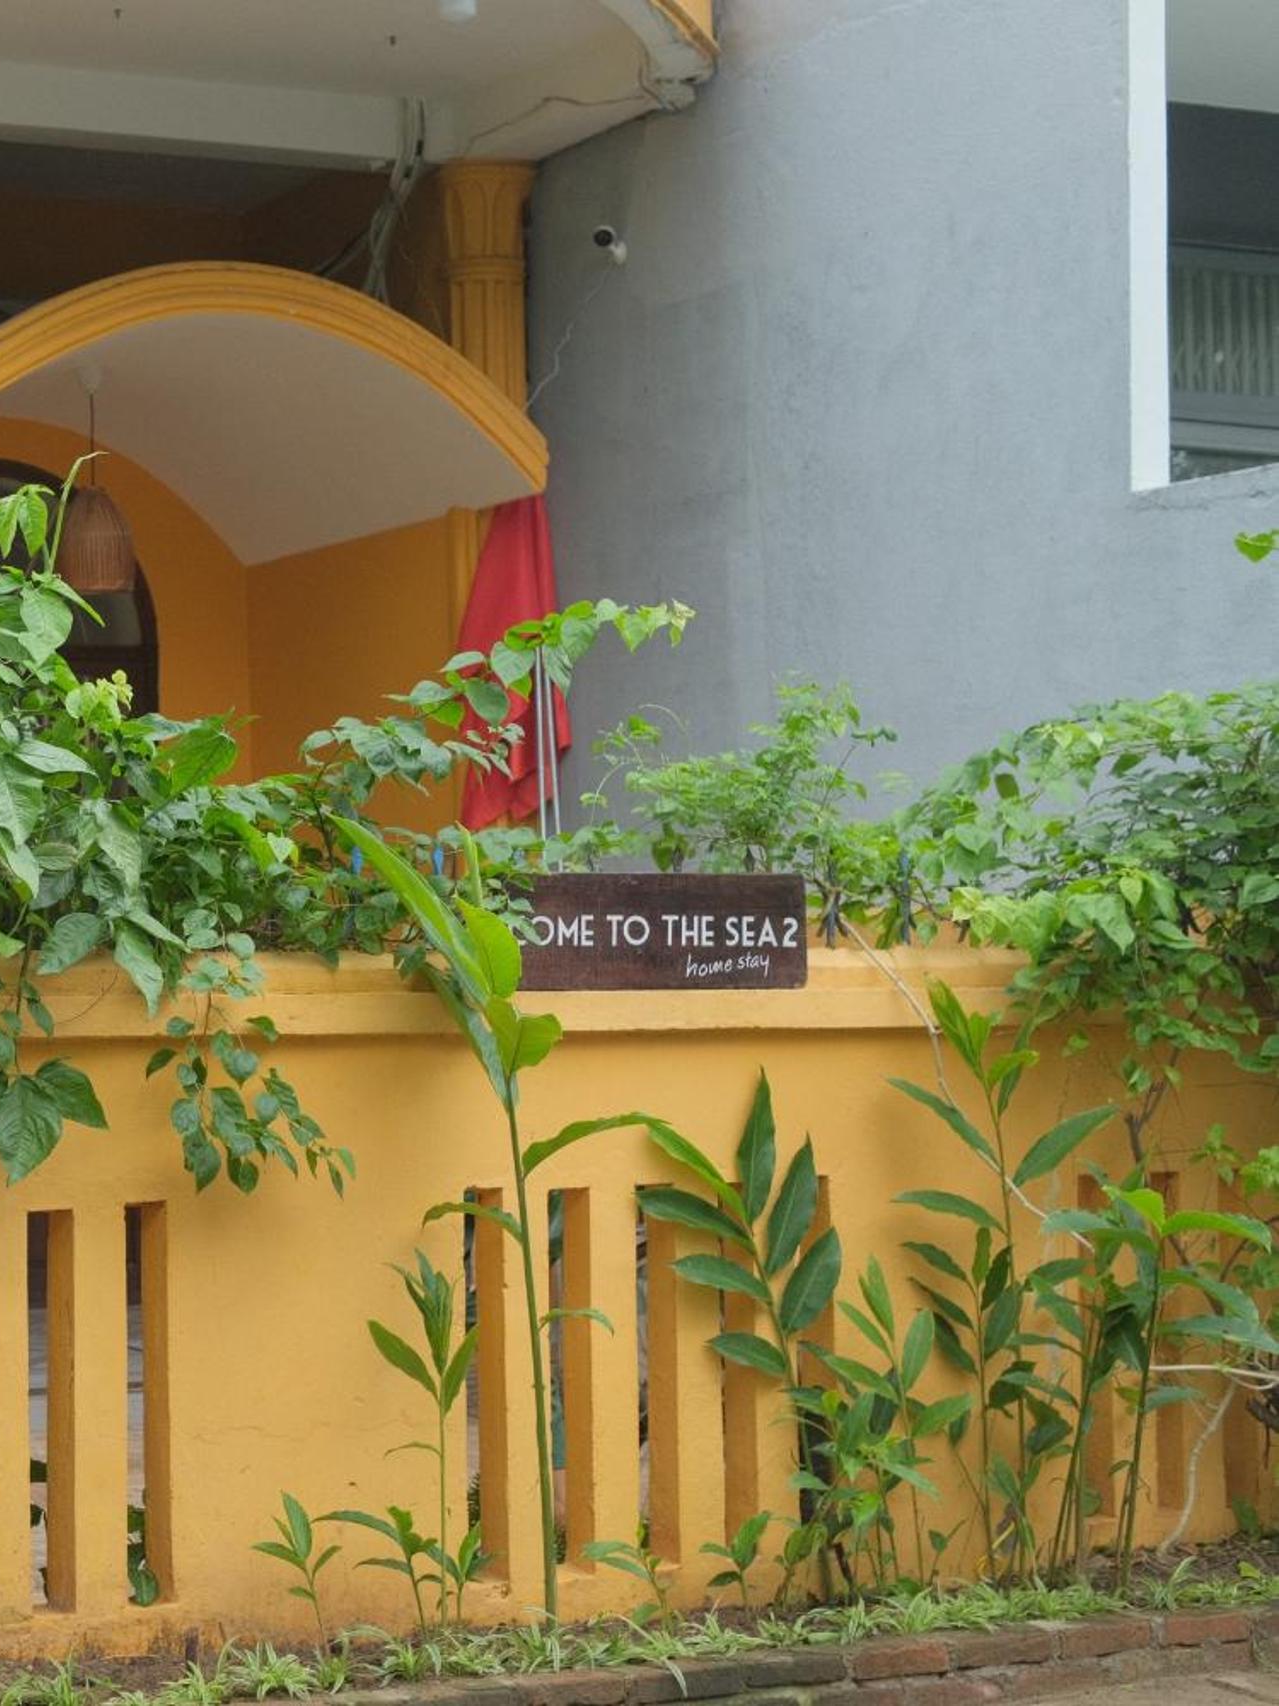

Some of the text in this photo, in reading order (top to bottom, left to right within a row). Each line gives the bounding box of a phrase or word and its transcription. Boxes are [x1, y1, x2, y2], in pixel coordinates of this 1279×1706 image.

[518, 914, 594, 947] OME
[606, 914, 651, 947] TO
[661, 914, 715, 948] THE
[685, 951, 771, 979] home stay
